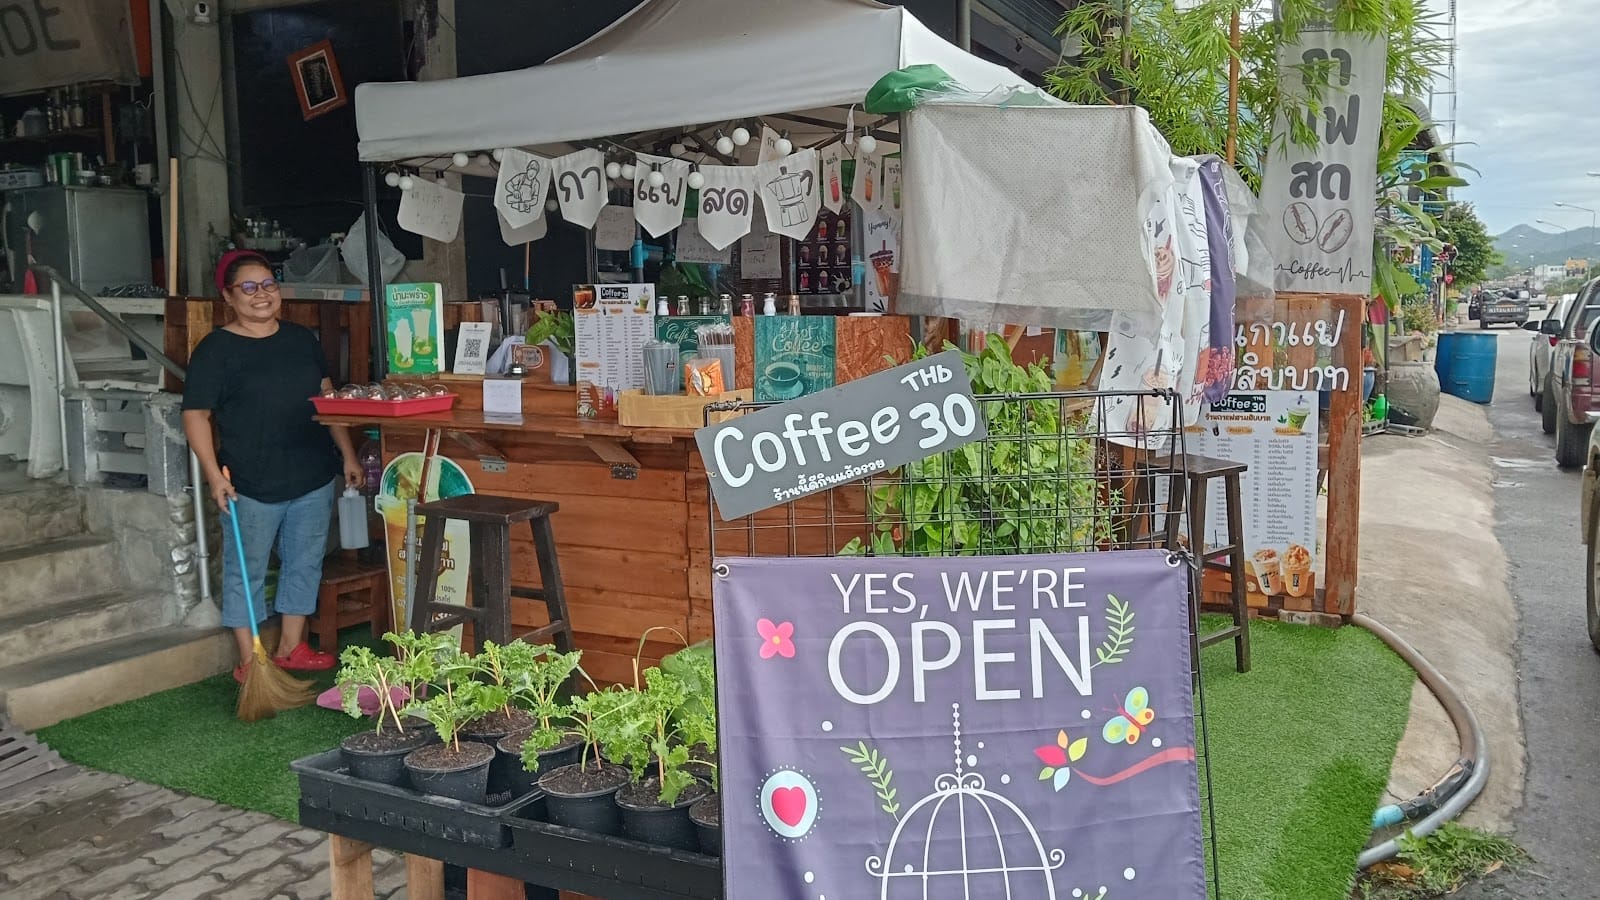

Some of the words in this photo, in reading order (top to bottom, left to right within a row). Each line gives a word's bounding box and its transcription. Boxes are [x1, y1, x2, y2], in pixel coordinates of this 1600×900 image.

[1289, 161, 1351, 201] สด
[1290, 259, 1333, 280] Coffee
[772, 333, 825, 354] Coffee
[1252, 402, 1266, 412] 30
[713, 405, 901, 488] Coffee
[909, 393, 976, 449] 30
[830, 572, 929, 620] YES,
[940, 567, 1088, 613] WE'RE
[827, 614, 1094, 705] OPEN
